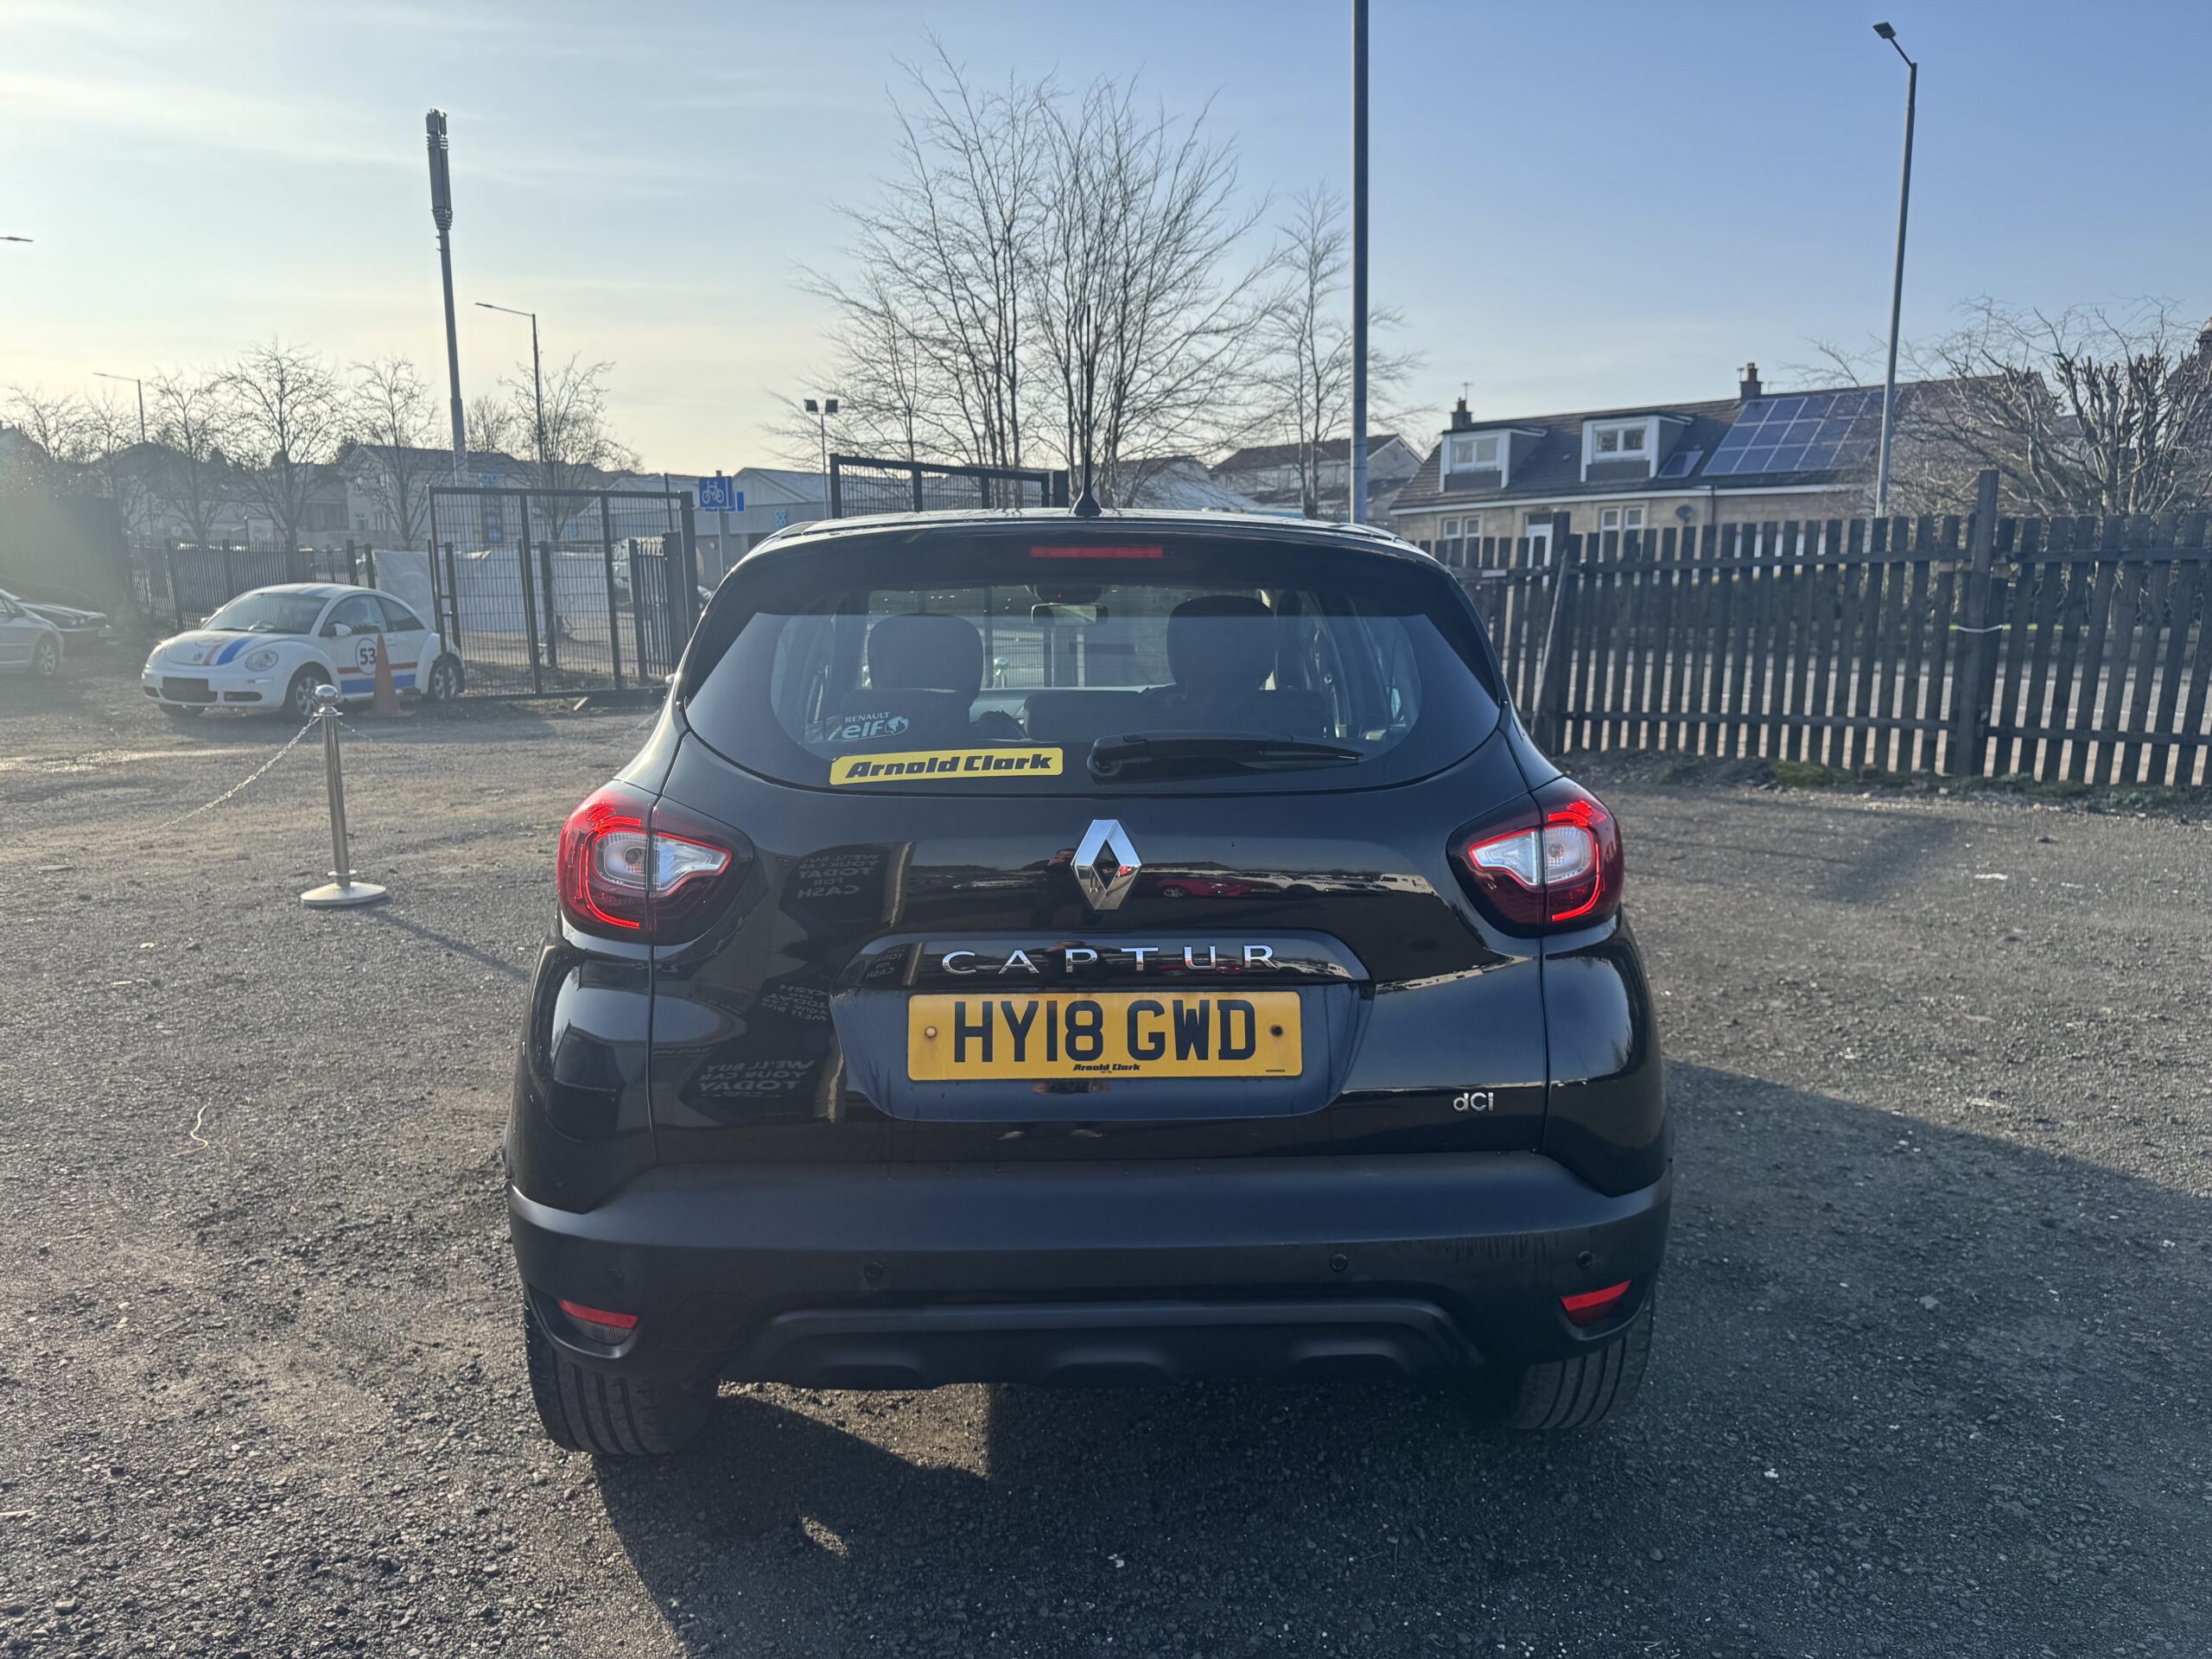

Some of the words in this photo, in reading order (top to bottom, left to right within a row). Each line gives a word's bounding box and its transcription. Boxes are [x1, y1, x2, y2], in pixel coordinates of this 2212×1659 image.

[359, 647, 377, 665] 53
[845, 711, 891, 723] RENAULT
[842, 720, 885, 740] elf
[845, 756, 961, 779] Arnold
[963, 753, 1053, 772] Clark
[942, 944, 1278, 975] CAPTUR
[954, 1000, 1104, 1063] HY18
[1127, 999, 1256, 1061] GWD
[1452, 1091, 1494, 1112] dCi
